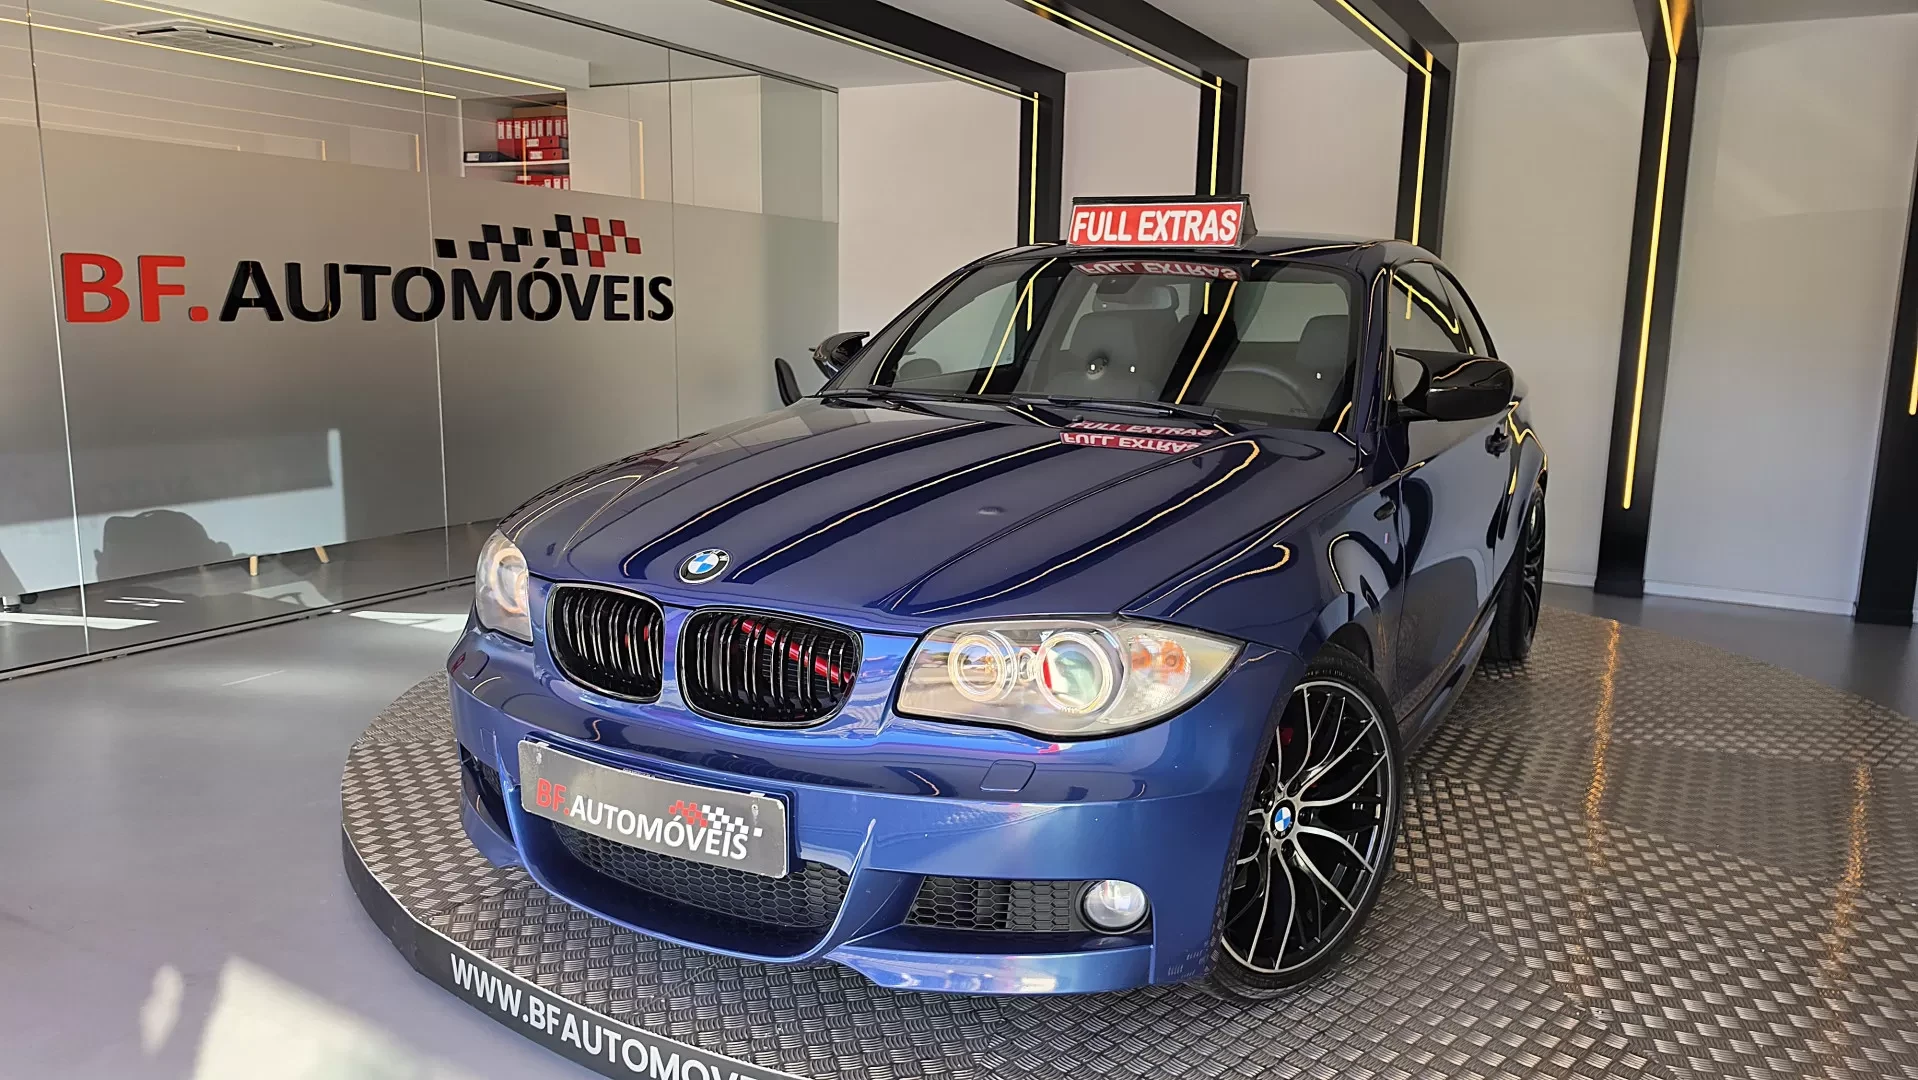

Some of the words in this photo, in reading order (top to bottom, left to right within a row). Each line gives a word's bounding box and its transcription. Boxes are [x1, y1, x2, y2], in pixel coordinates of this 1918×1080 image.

[1072, 210, 1132, 242] FULL
[1137, 208, 1237, 242] EXTRAS
[450, 952, 758, 1080] WWW.BFAUTOMO
